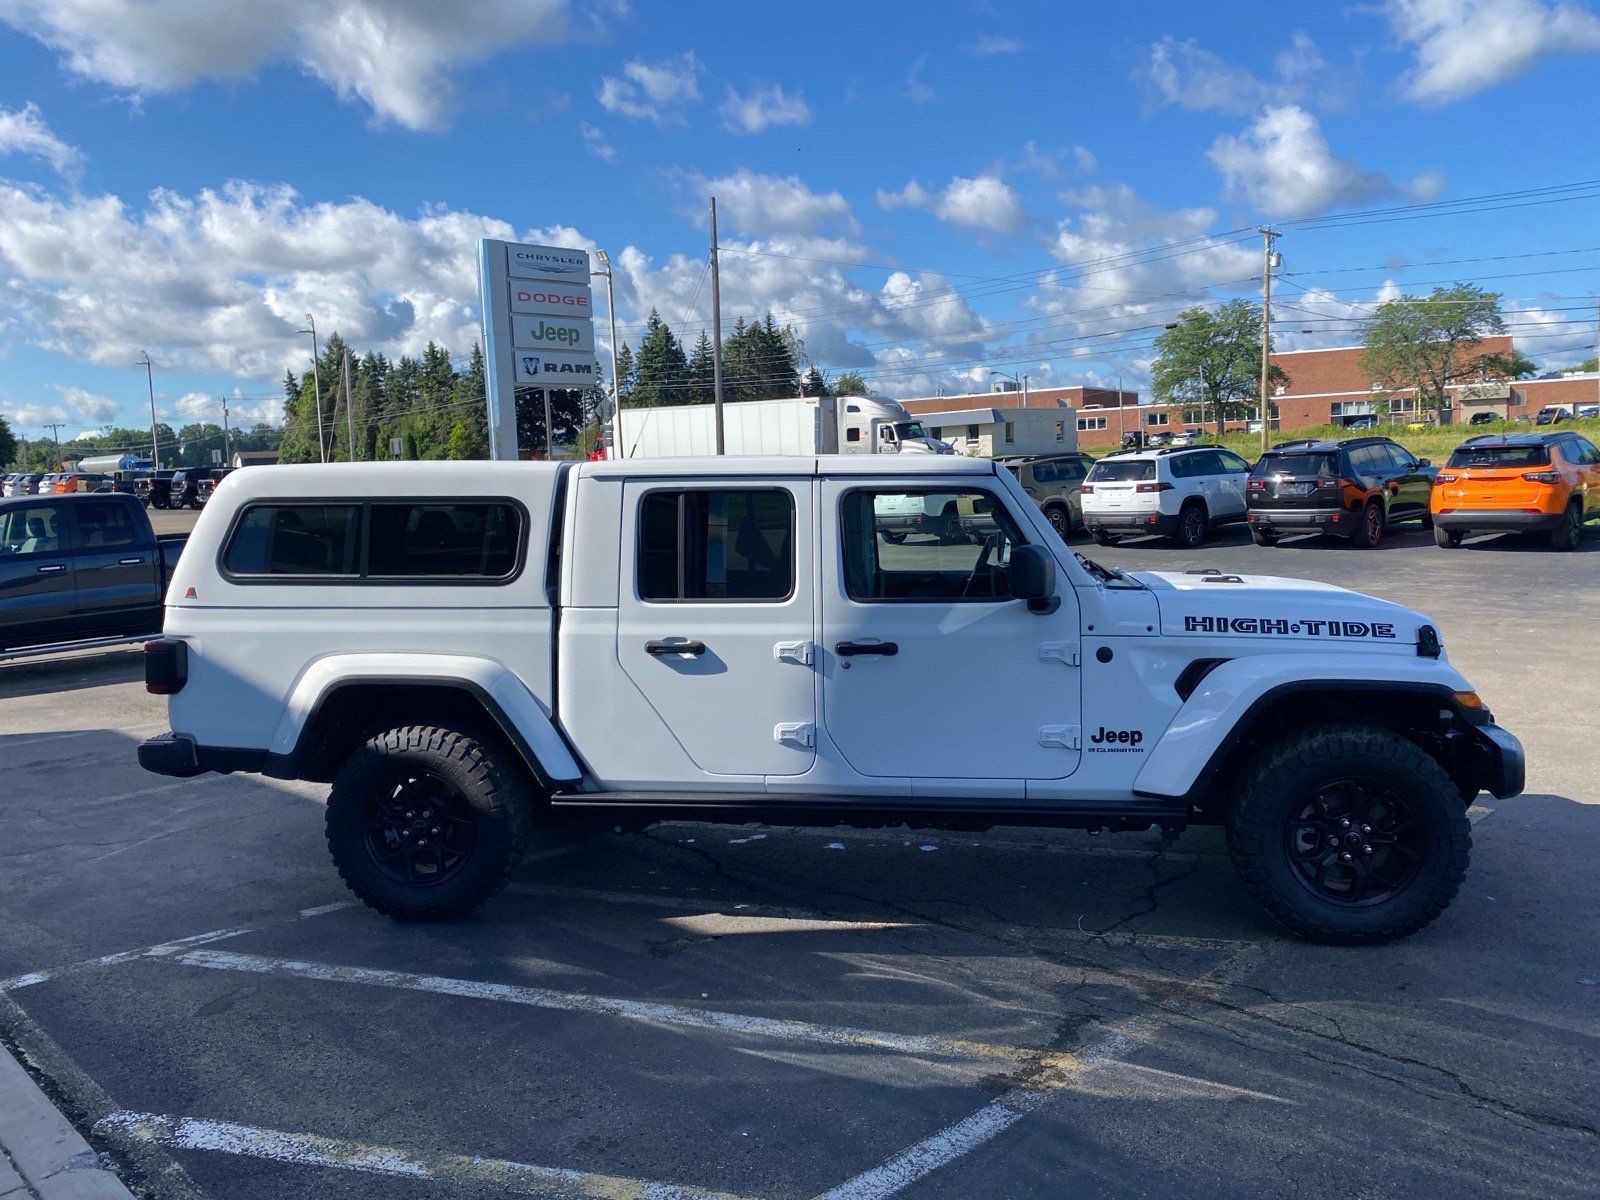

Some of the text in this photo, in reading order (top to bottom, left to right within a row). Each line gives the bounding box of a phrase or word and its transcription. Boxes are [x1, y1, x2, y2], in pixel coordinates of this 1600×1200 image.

[516, 252, 584, 265] CHRYSLER
[517, 292, 588, 307] DODGE
[531, 320, 581, 346] Jeep
[544, 362, 592, 374] RAM
[1184, 616, 1396, 638] HIGH TIDE
[1091, 726, 1143, 746] Jeep
